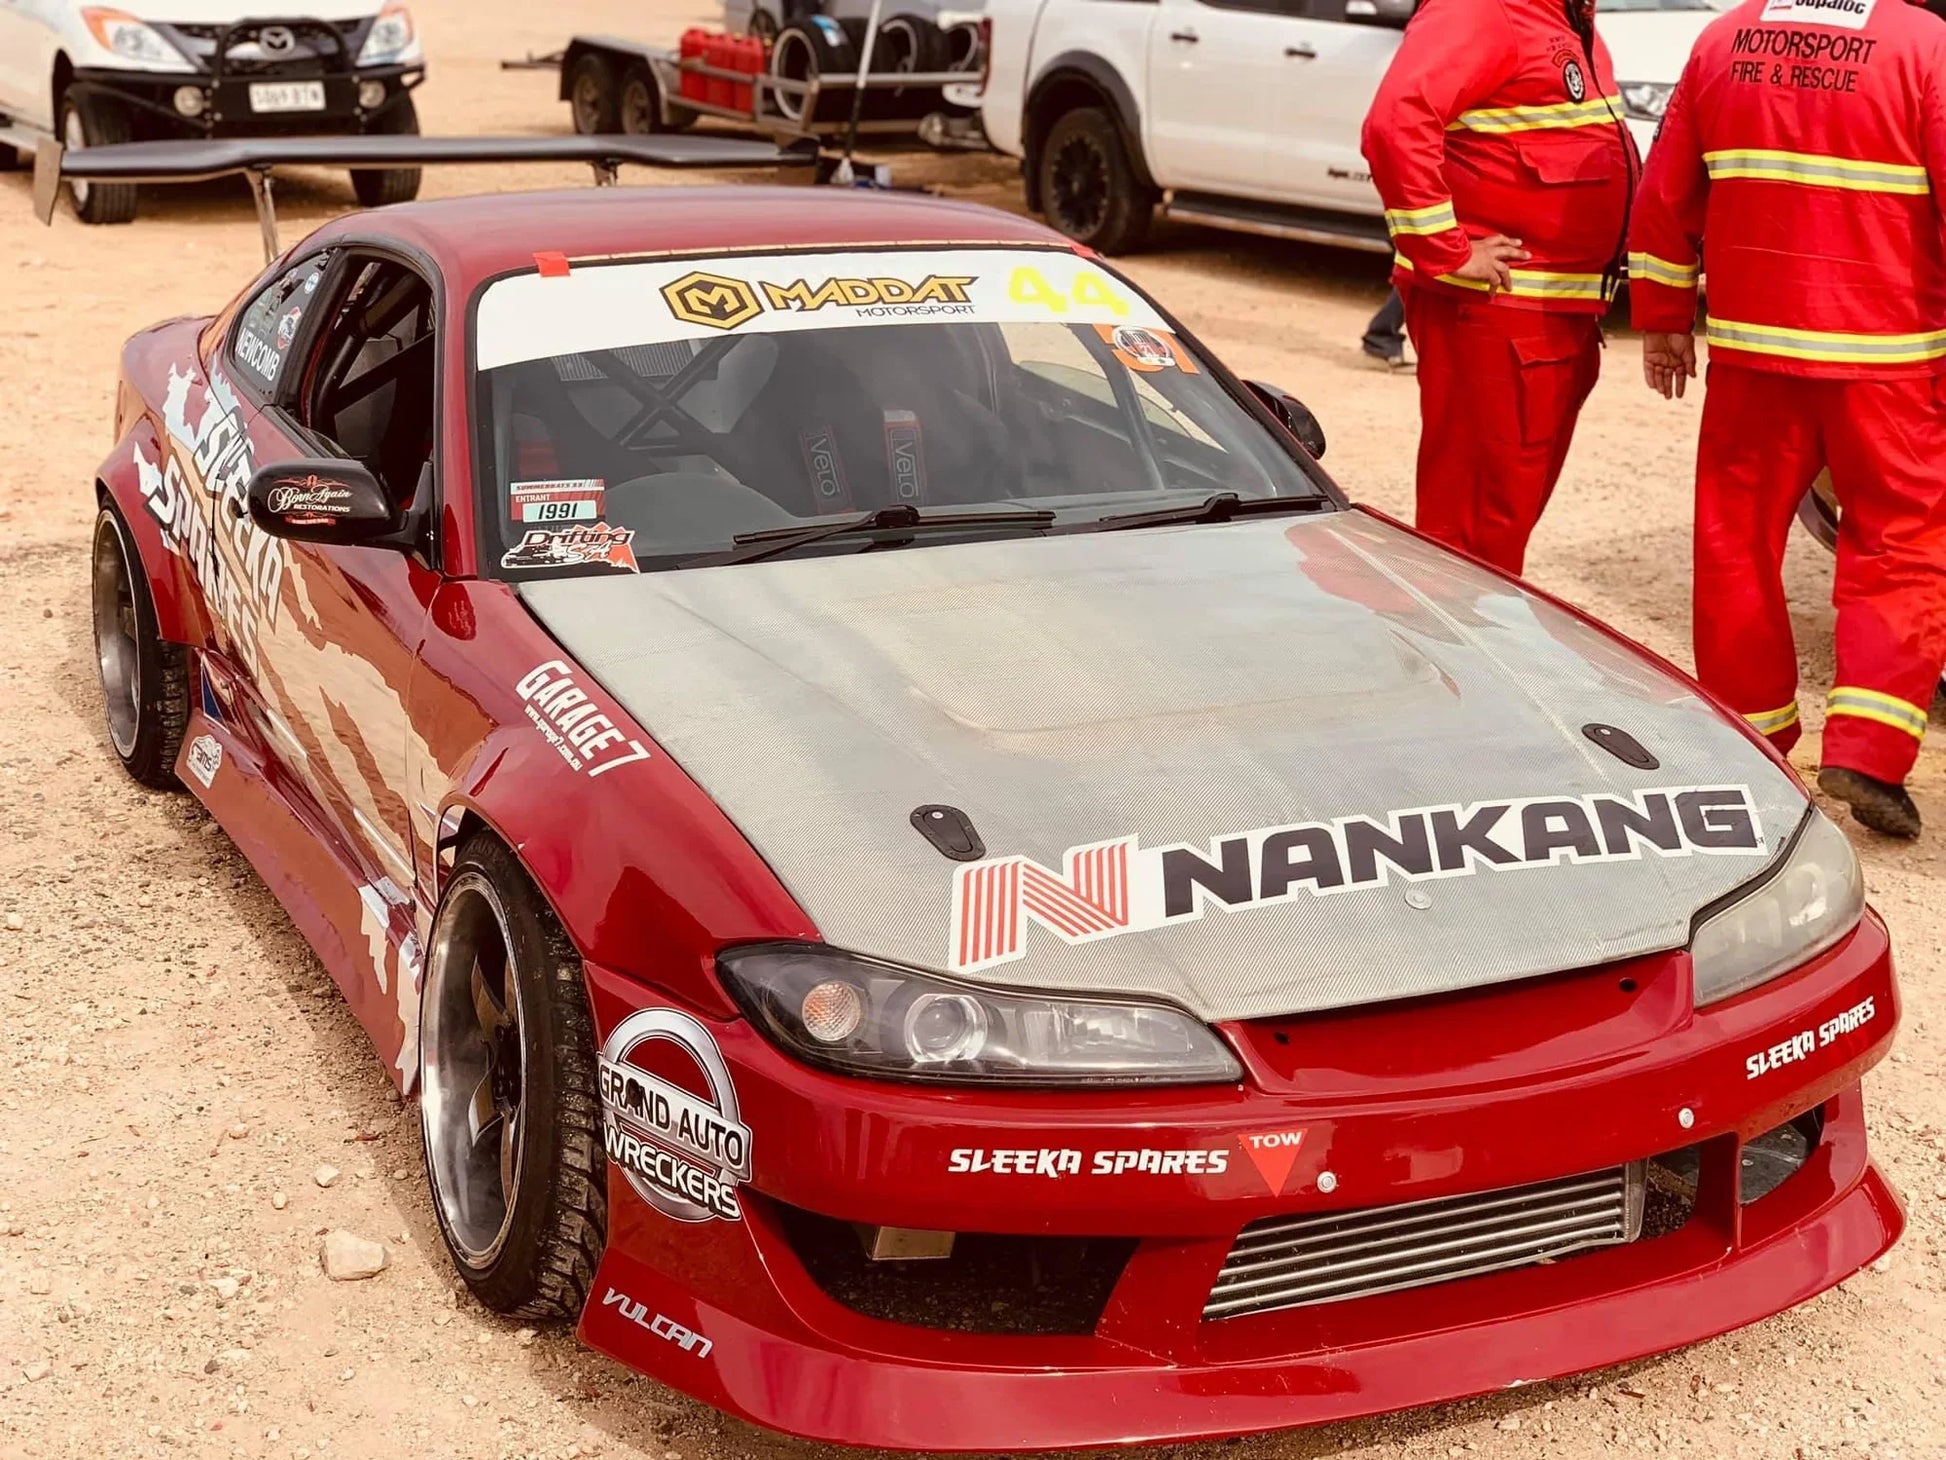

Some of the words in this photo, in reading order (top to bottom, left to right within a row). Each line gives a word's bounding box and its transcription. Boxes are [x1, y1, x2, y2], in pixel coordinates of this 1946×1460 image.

[1731, 28, 1877, 64] MOTORSPORT
[1730, 61, 1766, 84] FIRE
[1770, 63, 1783, 86] &
[1790, 65, 1859, 92] RESCUE
[758, 274, 979, 312] MADDAT
[1009, 266, 1131, 316] 44
[856, 305, 976, 318] MOTORSPORT
[235, 327, 280, 381] NEWCOMB
[267, 486, 311, 514] Born
[311, 484, 353, 503] Again
[293, 504, 351, 513] RESTORATIONS
[515, 494, 551, 503] ENTRANT
[538, 502, 578, 520] 1991
[524, 530, 632, 546] Drifting
[515, 660, 626, 760] GARAGE
[587, 739, 651, 777] 7
[1164, 789, 1759, 918] NANKANG
[1745, 1030, 1815, 1080] SLEEKA
[1818, 995, 1875, 1047] SPARES
[600, 1064, 671, 1132] GRAND
[679, 1107, 744, 1170] AUTO
[1249, 1131, 1302, 1149] TOW
[602, 1120, 741, 1218] WRECKERS
[948, 1148, 1082, 1179] SLEEKA
[1091, 1149, 1230, 1175] SPARES
[602, 1286, 714, 1359] VULCAN
